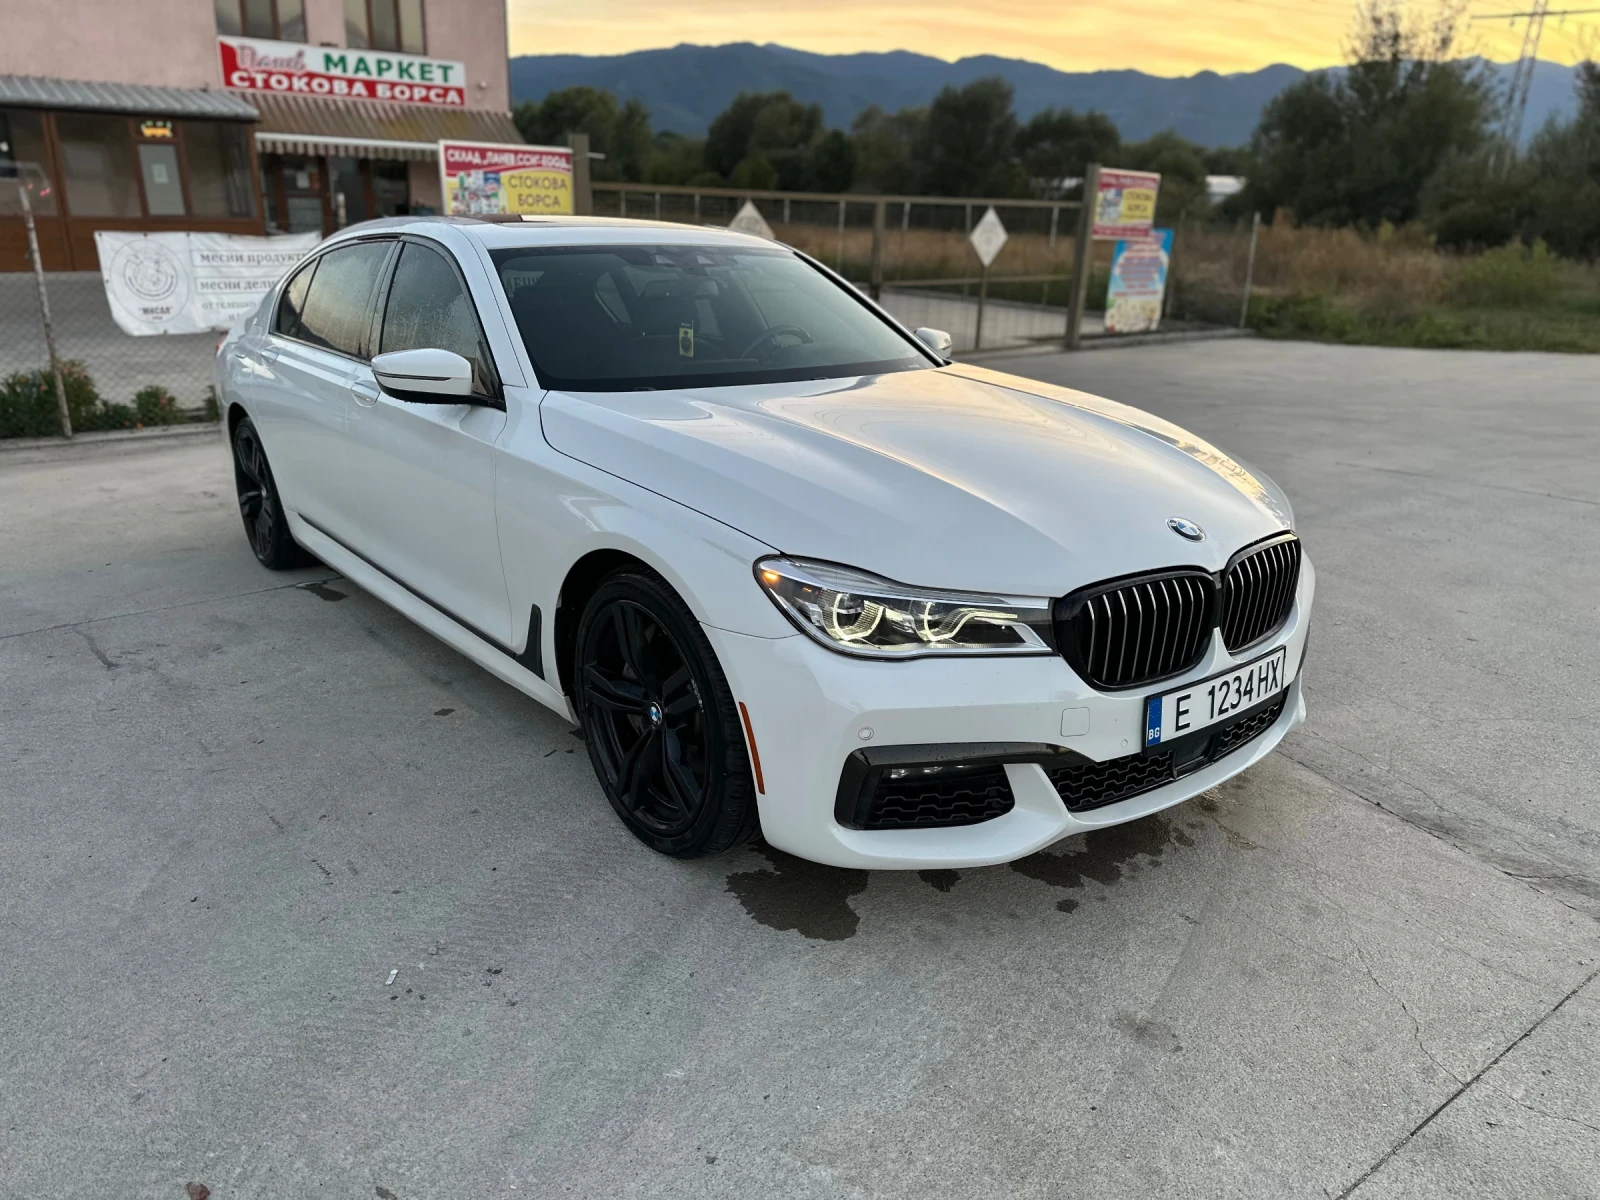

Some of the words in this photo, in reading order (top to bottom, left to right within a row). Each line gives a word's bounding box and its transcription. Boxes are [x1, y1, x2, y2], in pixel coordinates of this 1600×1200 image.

[323, 53, 454, 83] МАРКЕТ
[230, 70, 368, 97] СТОКОВА
[375, 82, 463, 105] БОРСА
[508, 174, 568, 190] СТОКОВА
[517, 193, 561, 208] БОРСА
[200, 252, 242, 263] месни
[200, 280, 241, 290] месни
[1175, 693, 1192, 732] E
[1148, 727, 1160, 740] BG
